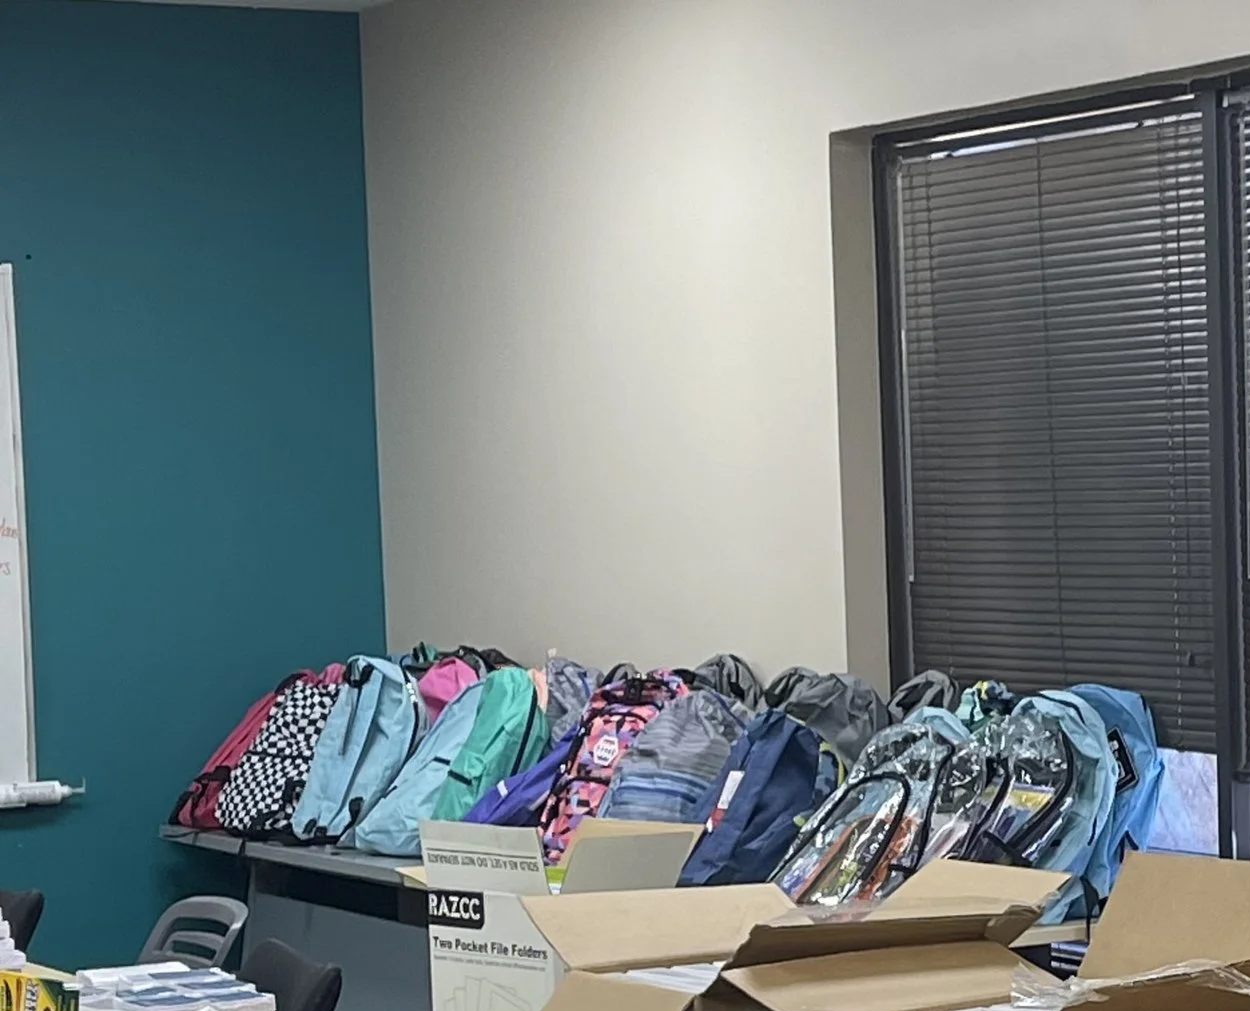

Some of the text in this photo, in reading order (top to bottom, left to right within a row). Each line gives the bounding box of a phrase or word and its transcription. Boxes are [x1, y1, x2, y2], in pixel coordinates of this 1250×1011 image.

[432, 935, 548, 961] Two Pocket File Folders
